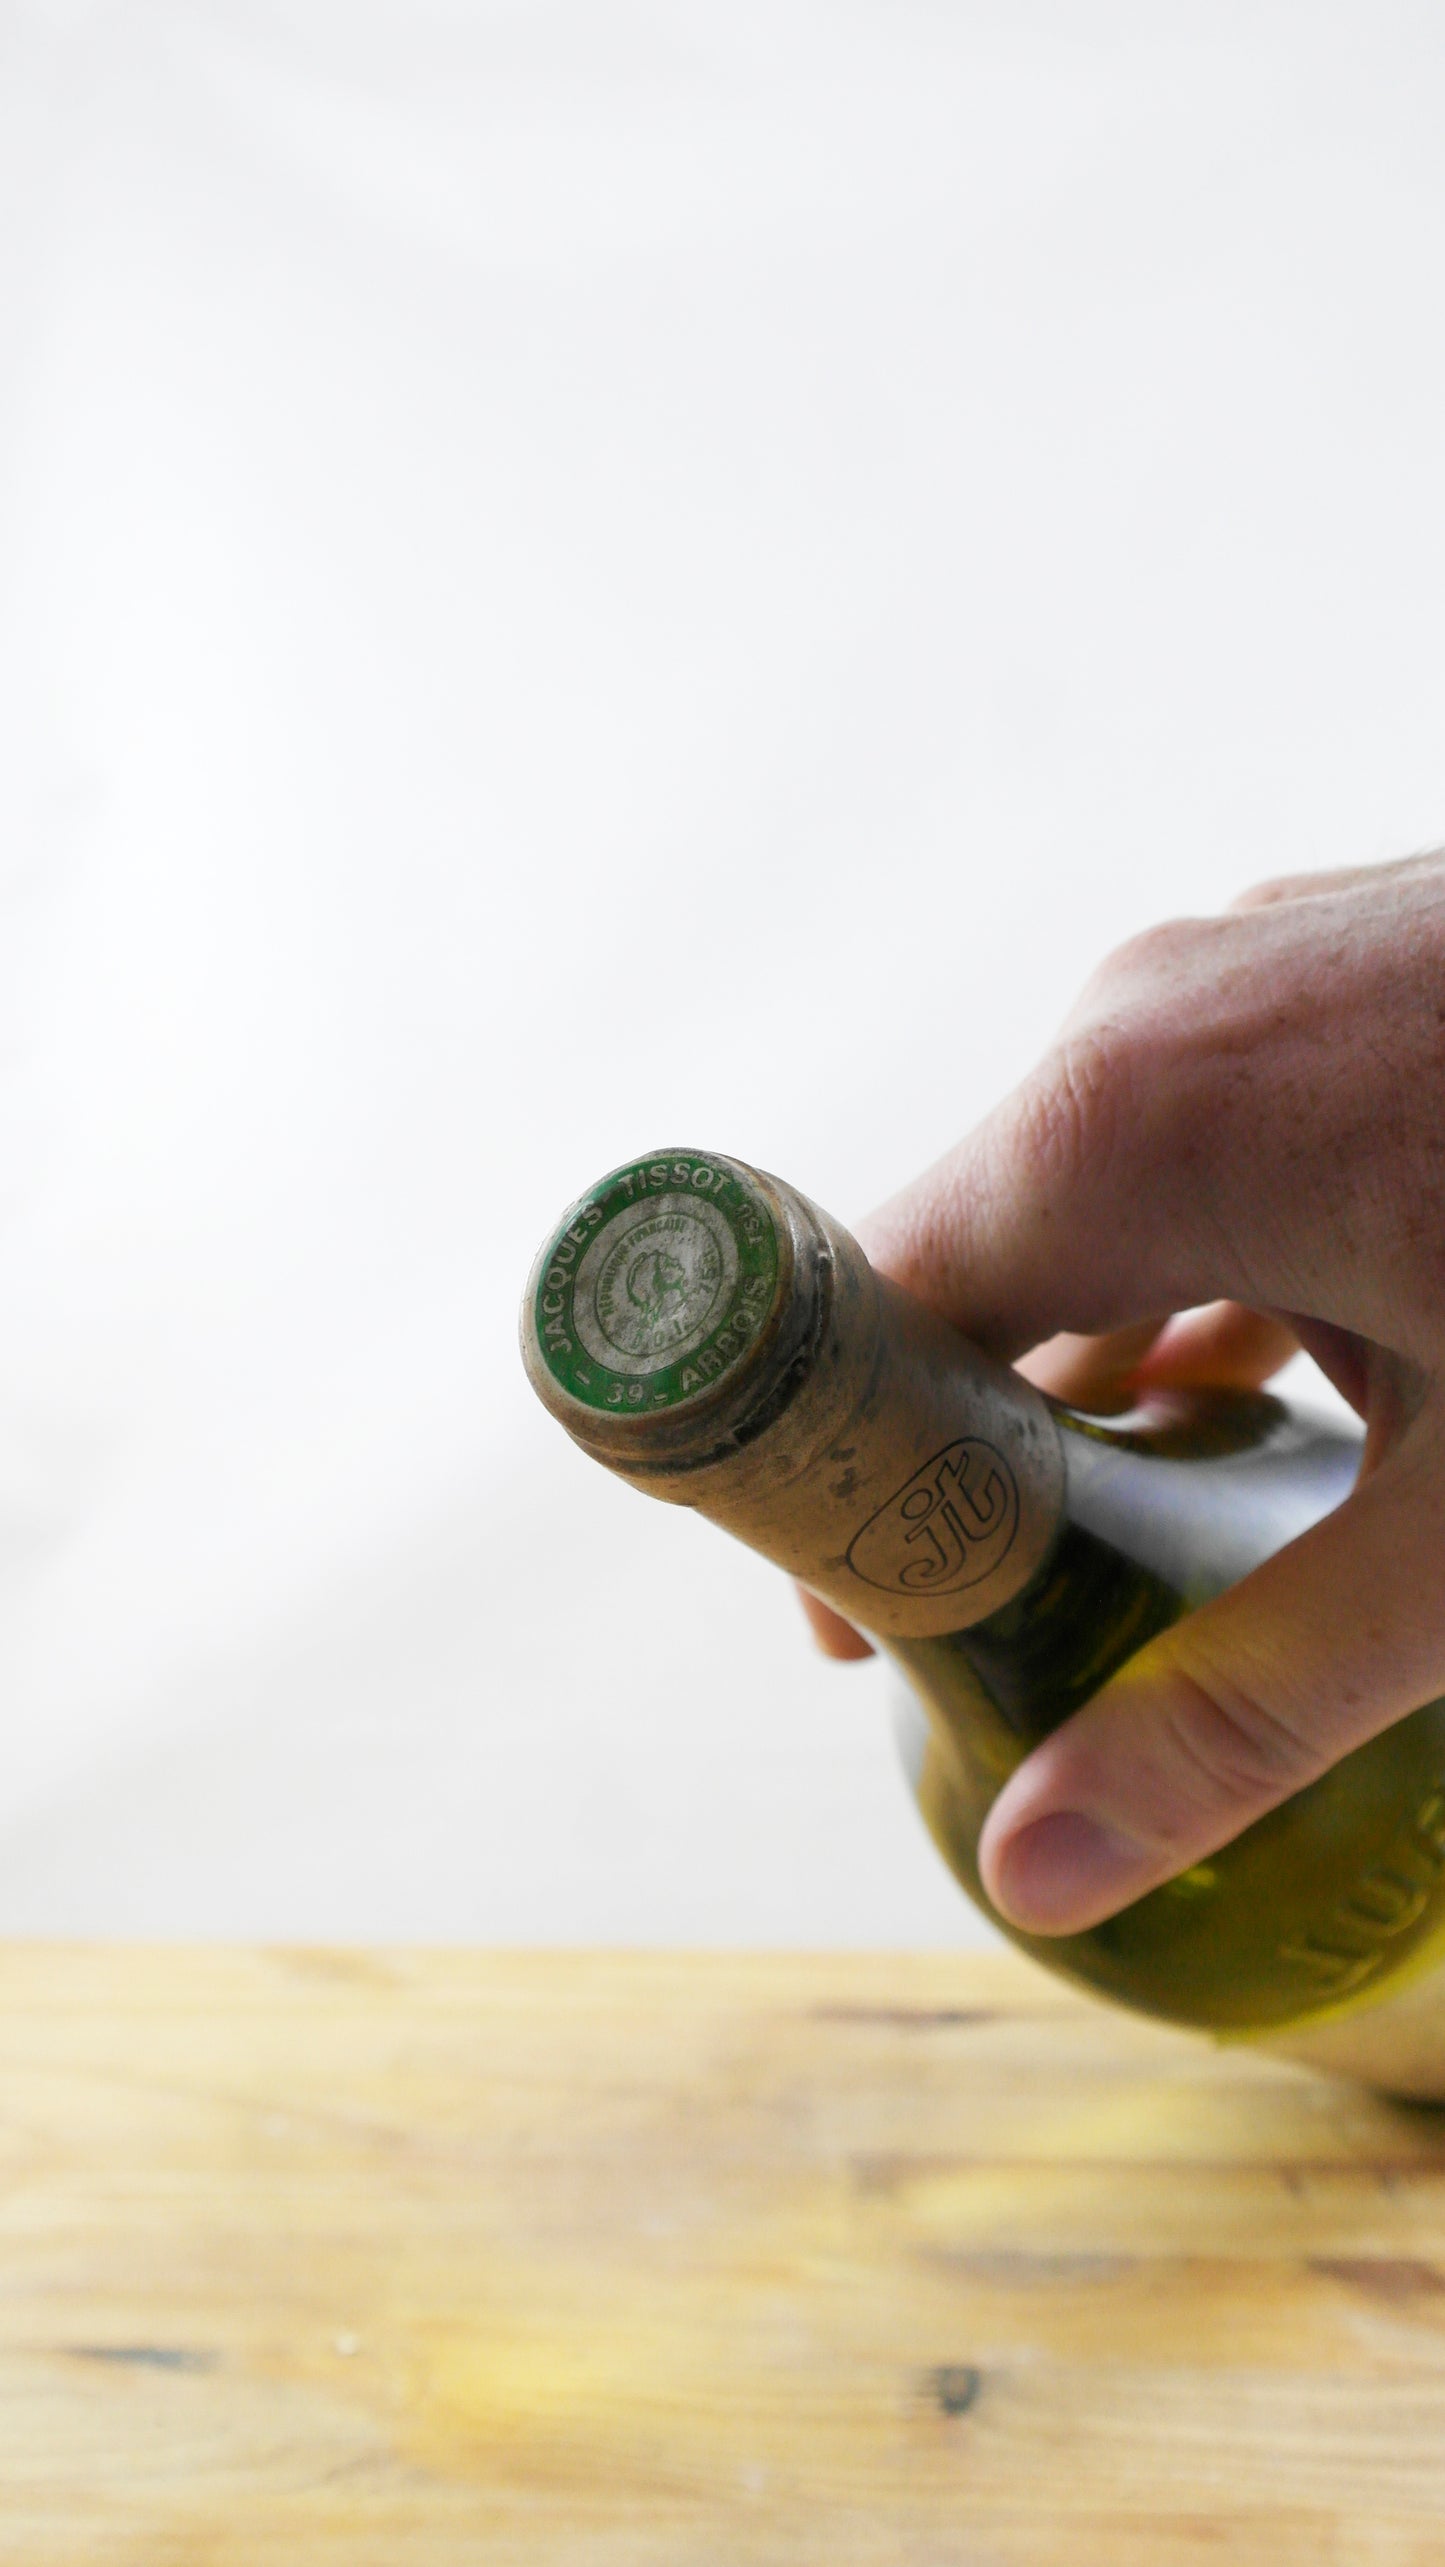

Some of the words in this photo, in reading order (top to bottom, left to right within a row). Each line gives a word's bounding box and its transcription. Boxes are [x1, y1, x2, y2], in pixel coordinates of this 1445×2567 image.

[543, 1201, 604, 1354] JACQUES
[618, 1162, 732, 1197] TISSOT
[606, 1382, 644, 1405] 39
[681, 1275, 771, 1392] ARBOIS
